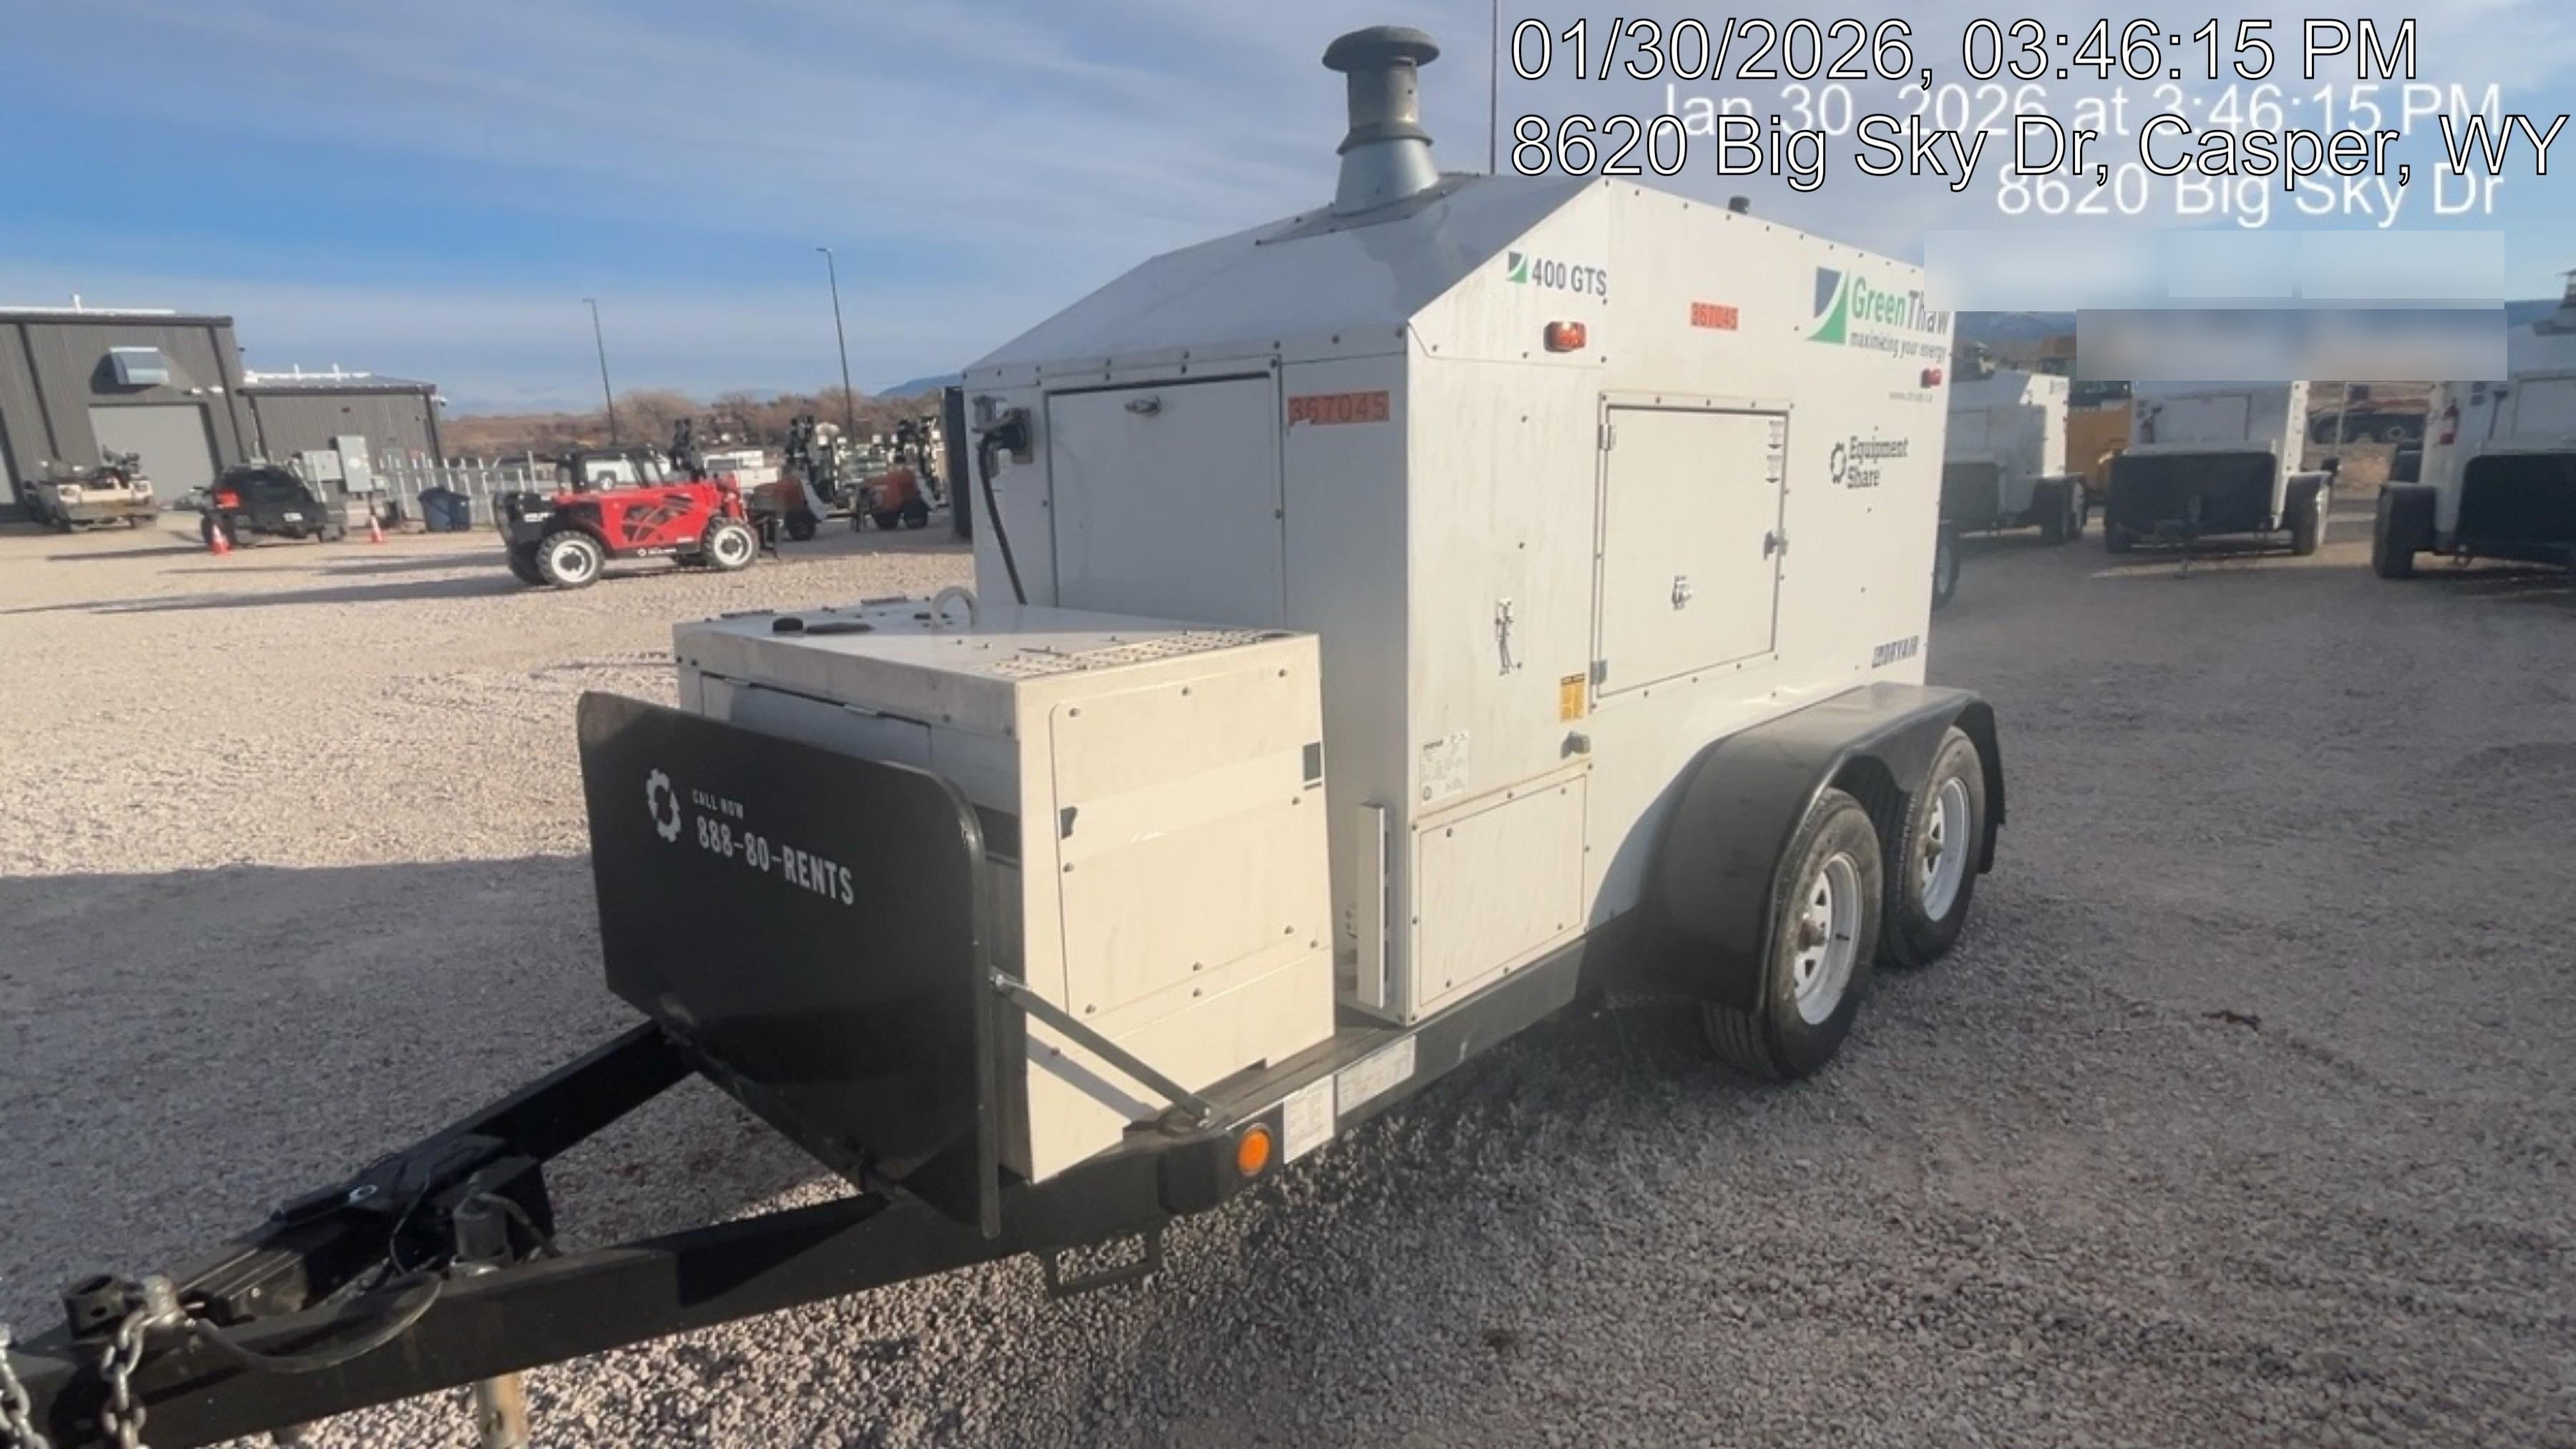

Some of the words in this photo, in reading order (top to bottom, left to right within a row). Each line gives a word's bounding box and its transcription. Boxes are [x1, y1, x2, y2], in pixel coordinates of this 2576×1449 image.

[1532, 258, 1566, 290] 400
[1571, 265, 1607, 296] GTS
[1901, 340, 1919, 359] your
[1289, 391, 1390, 424] 367045
[1849, 435, 1909, 464] Equipment
[1848, 467, 1880, 489] Share
[692, 789, 718, 811] CALL
[720, 798, 744, 819] NOW
[696, 815, 854, 906] 888-80-RENTS
